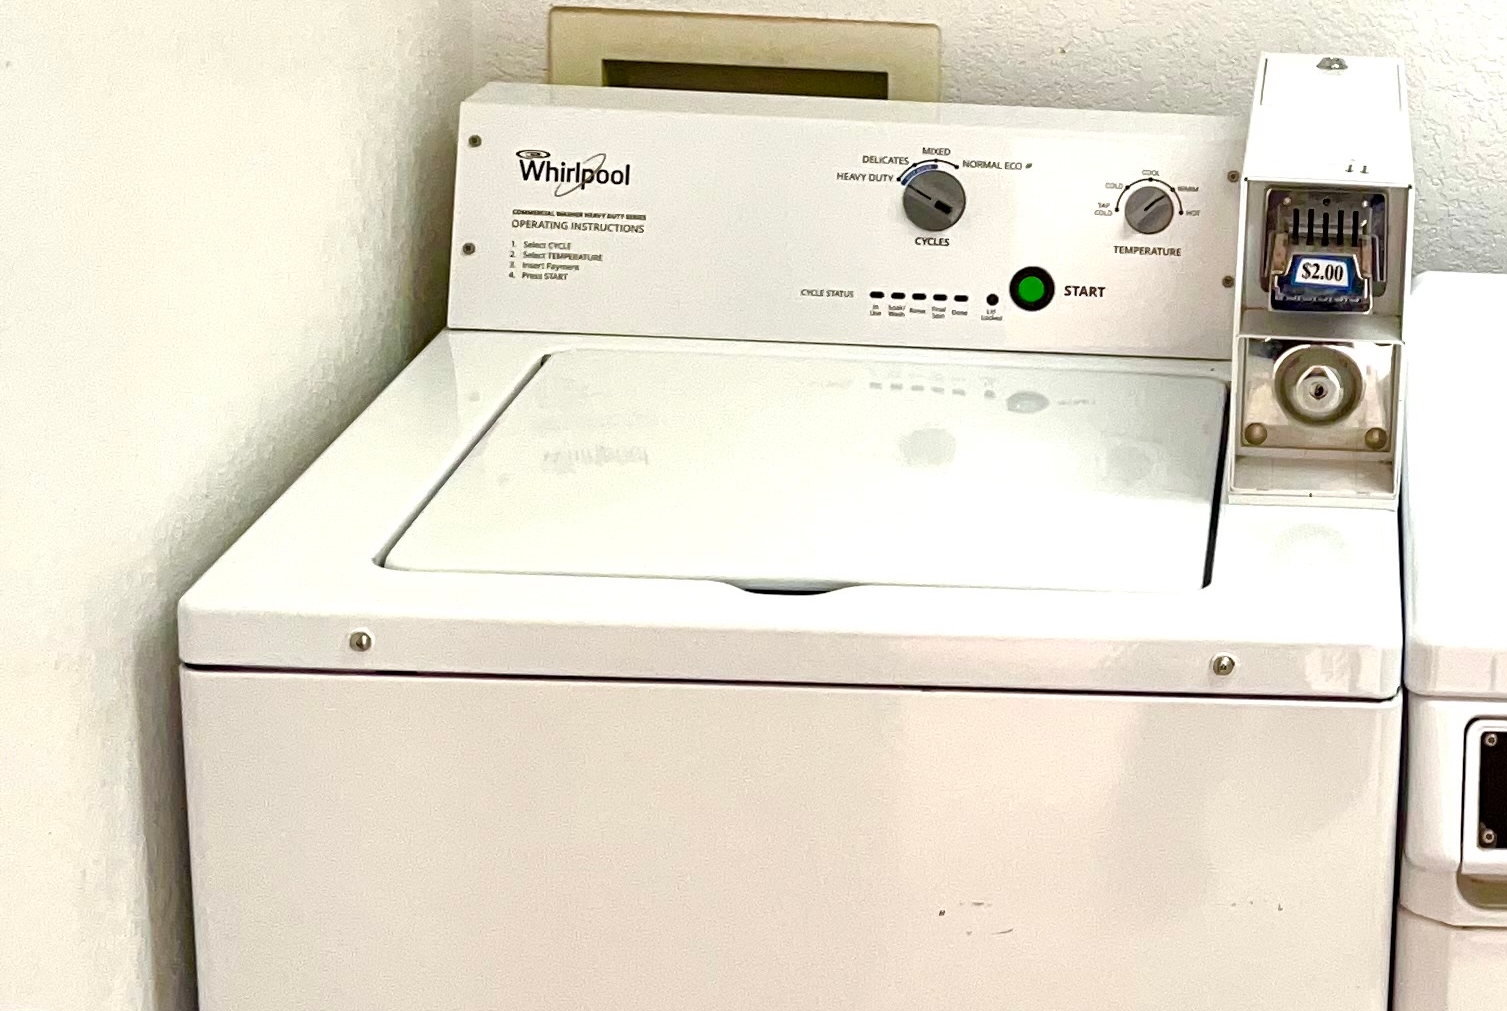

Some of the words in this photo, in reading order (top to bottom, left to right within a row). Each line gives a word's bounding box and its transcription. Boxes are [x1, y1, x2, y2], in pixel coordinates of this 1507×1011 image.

[922, 147, 951, 156] MIXED
[862, 155, 910, 165] DELICATES
[962, 159, 1002, 169] NORMAL
[1004, 161, 1023, 170] ECO
[519, 159, 630, 190] Whirlpool
[836, 172, 867, 182] HEAVY
[868, 174, 894, 183] DUTY
[511, 219, 569, 230] OPERATING
[571, 221, 645, 234] INSTRUCTIONS
[914, 237, 950, 247] CYCLES
[1113, 245, 1181, 257] TEMPERATURE
[1301, 262, 1344, 281] $2.00
[800, 289, 824, 297] CYCLE
[826, 289, 854, 298] STATUS
[1063, 285, 1106, 298] START
